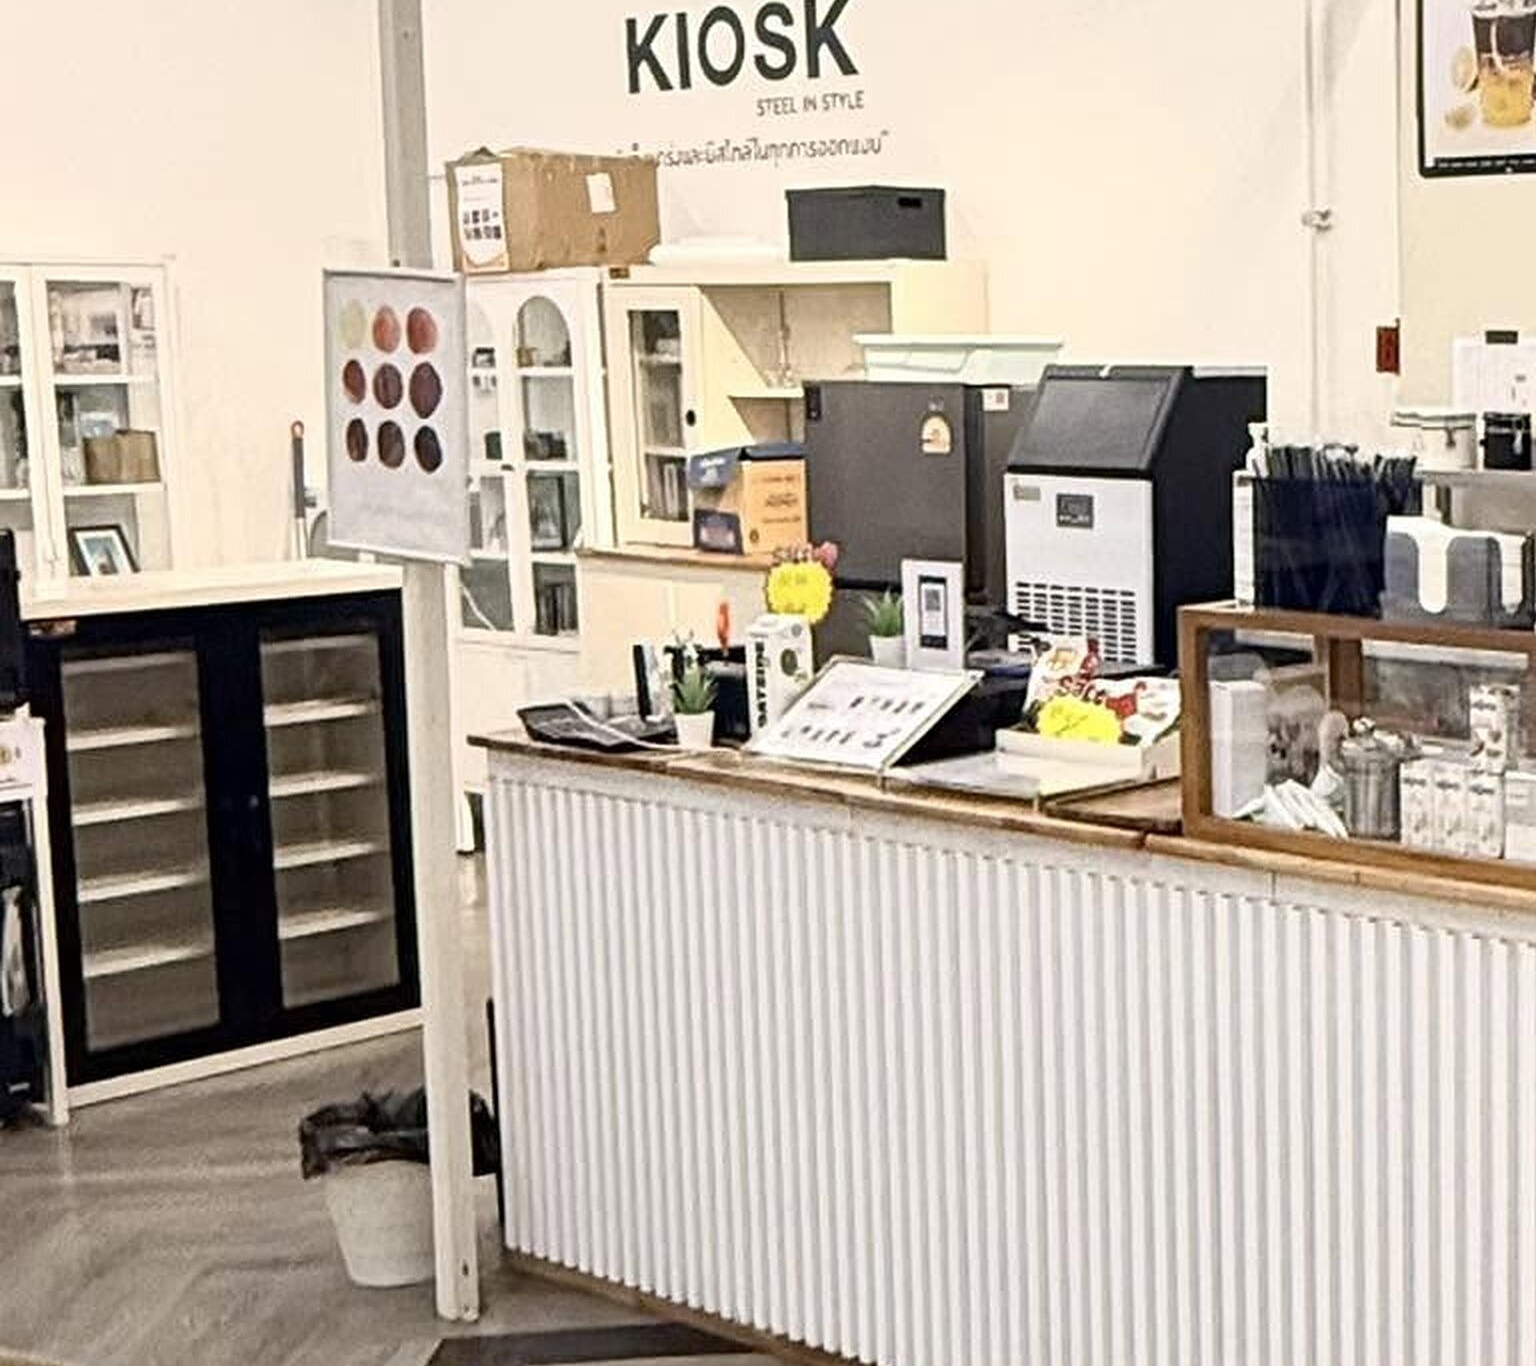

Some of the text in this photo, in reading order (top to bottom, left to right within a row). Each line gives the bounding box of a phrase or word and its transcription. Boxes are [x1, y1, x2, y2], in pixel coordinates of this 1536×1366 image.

[756, 90, 865, 117] STEEL IN STYLE
